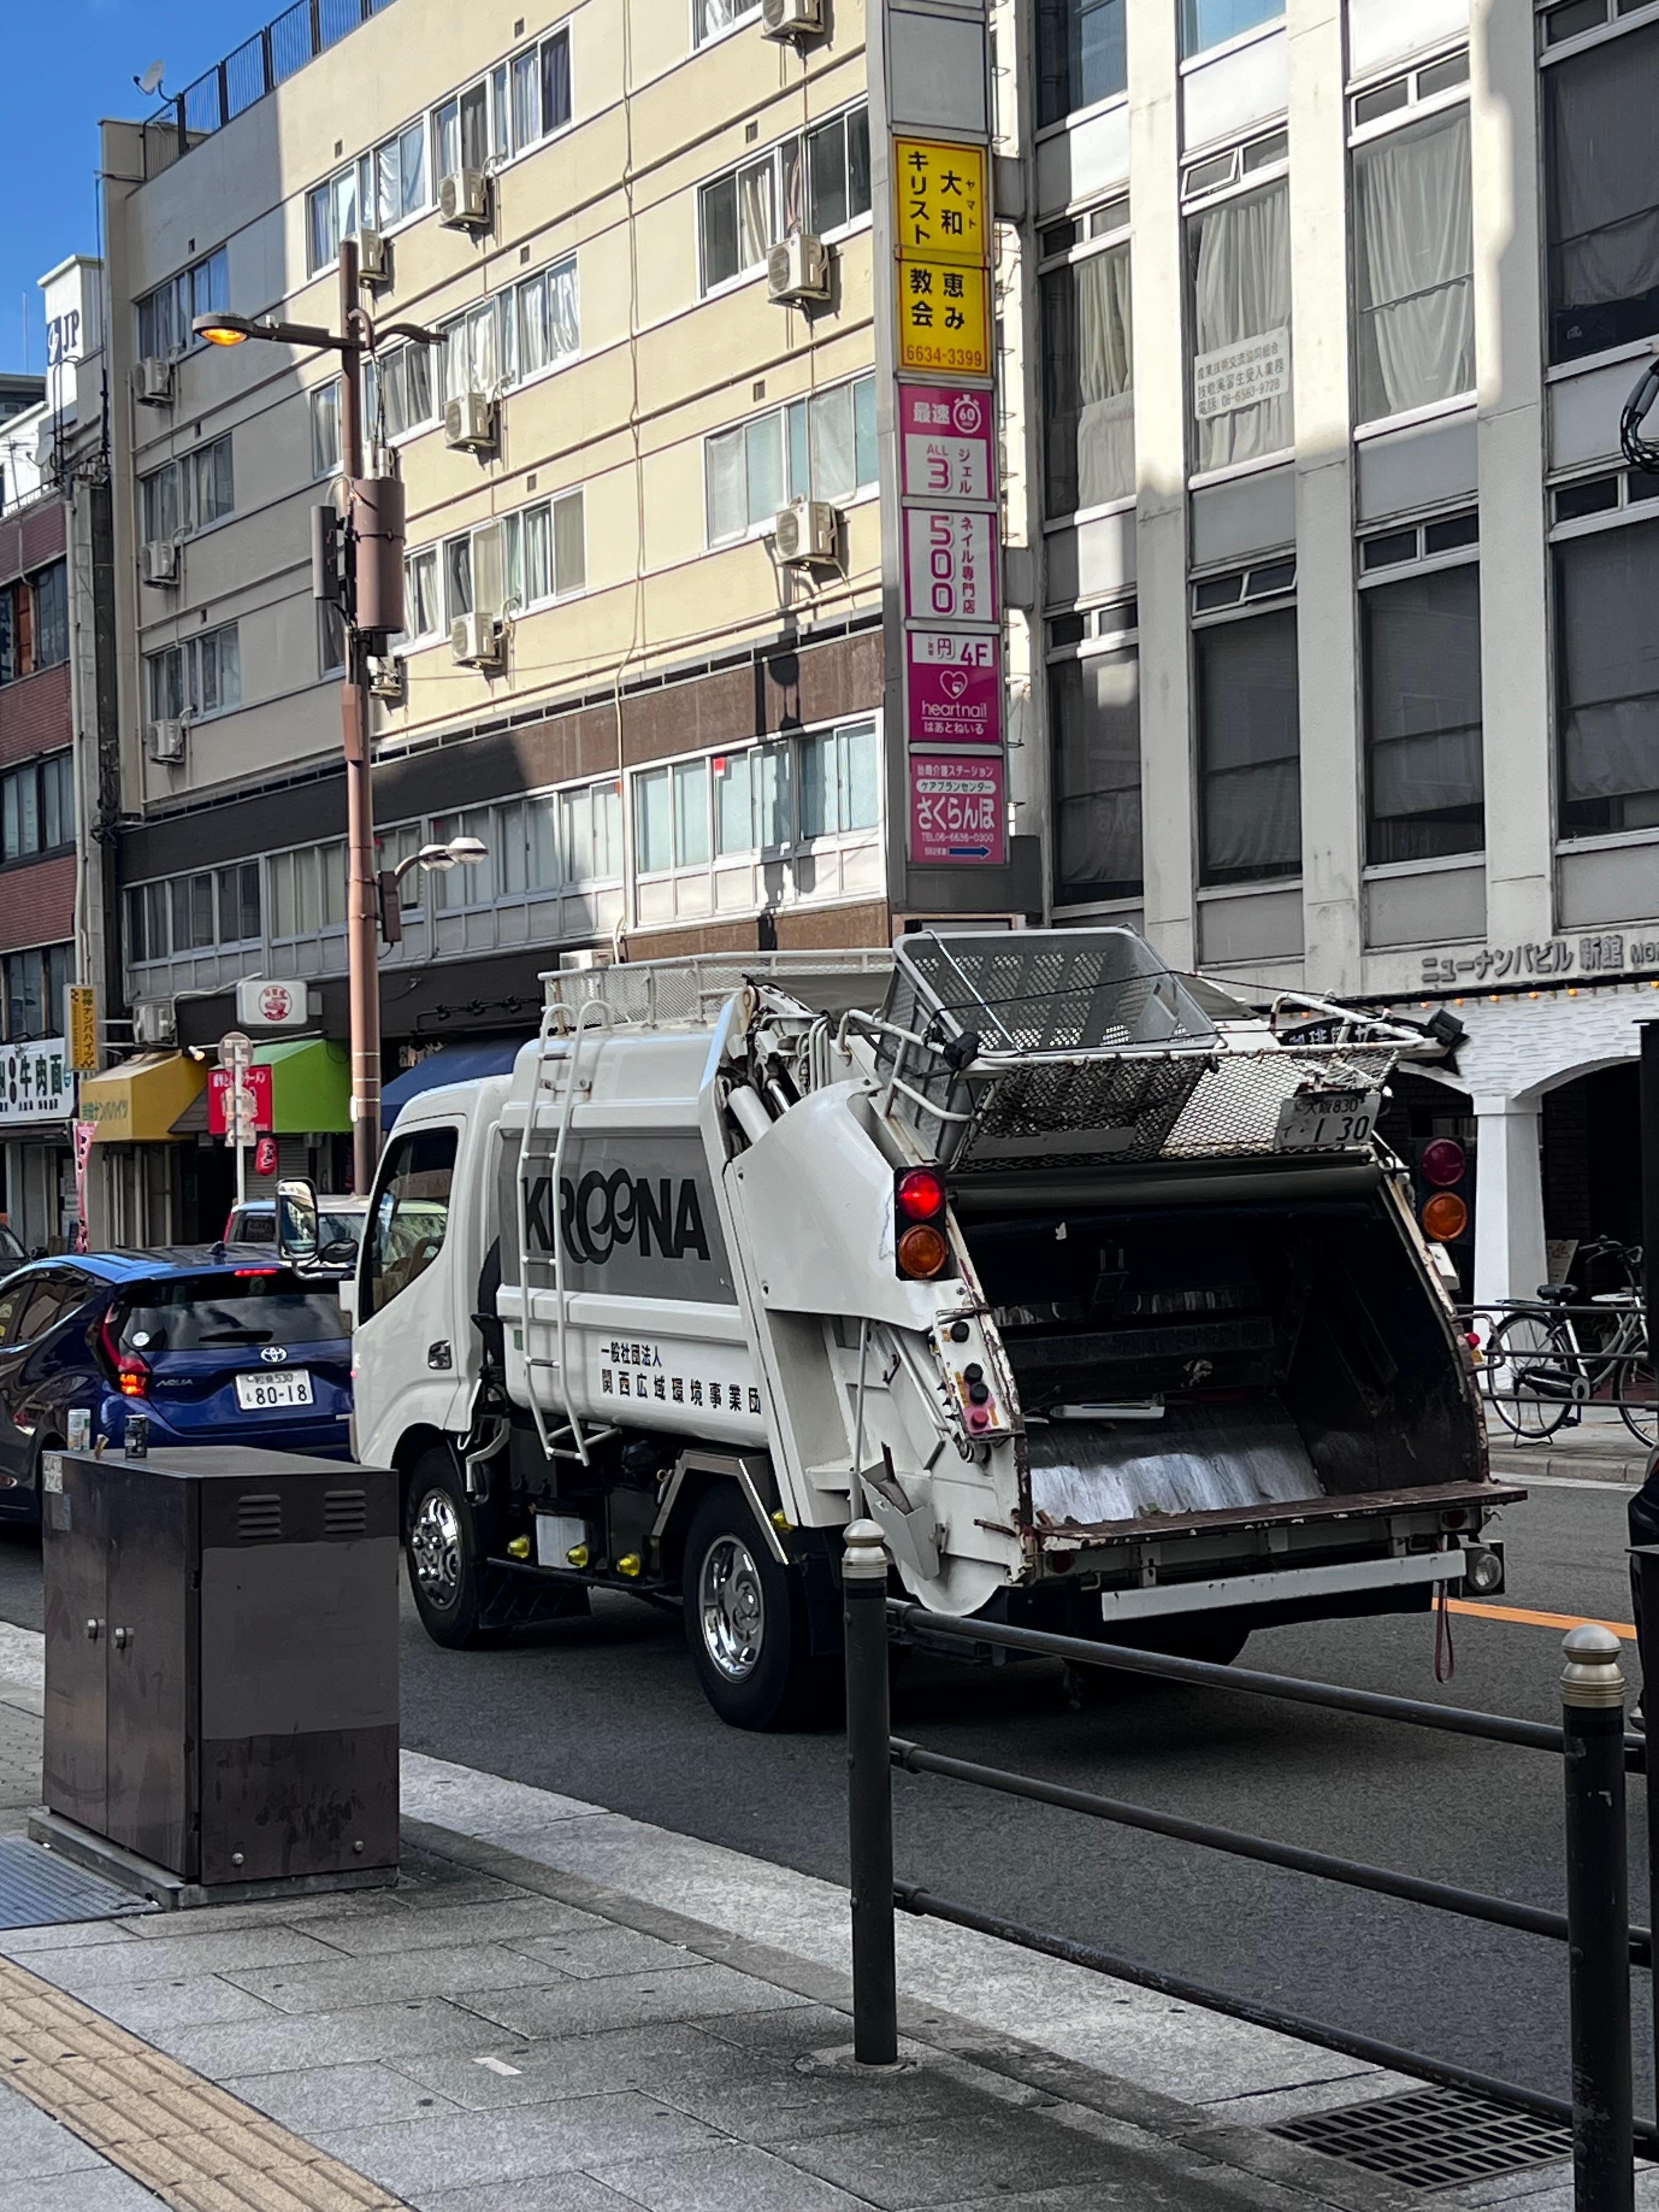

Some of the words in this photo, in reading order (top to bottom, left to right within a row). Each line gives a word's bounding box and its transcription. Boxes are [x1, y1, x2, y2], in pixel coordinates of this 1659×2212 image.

[908, 151, 930, 245] キリスト
[940, 170, 962, 235] 大和
[966, 179, 976, 229] ヤマト
[910, 268, 933, 328] 教会
[943, 273, 965, 330] 恵み
[64, 309, 80, 352] JP
[906, 344, 982, 367] 6634-3399
[913, 402, 950, 425] 最速
[959, 408, 975, 421] 60
[927, 443, 949, 456] ALL
[928, 458, 950, 490] 3
[958, 448, 972, 494] ジェル
[961, 516, 975, 614] ネイル専門店
[938, 638, 952, 655] 円
[960, 642, 989, 666] 4F
[924, 721, 984, 735] はあとねいる
[1579, 934, 1624, 971] 新館
[601, 1341, 663, 1368] 一般社団法人
[256, 1384, 308, 1406] 80-18
[601, 1368, 761, 1415] 関西広域環境事業団
